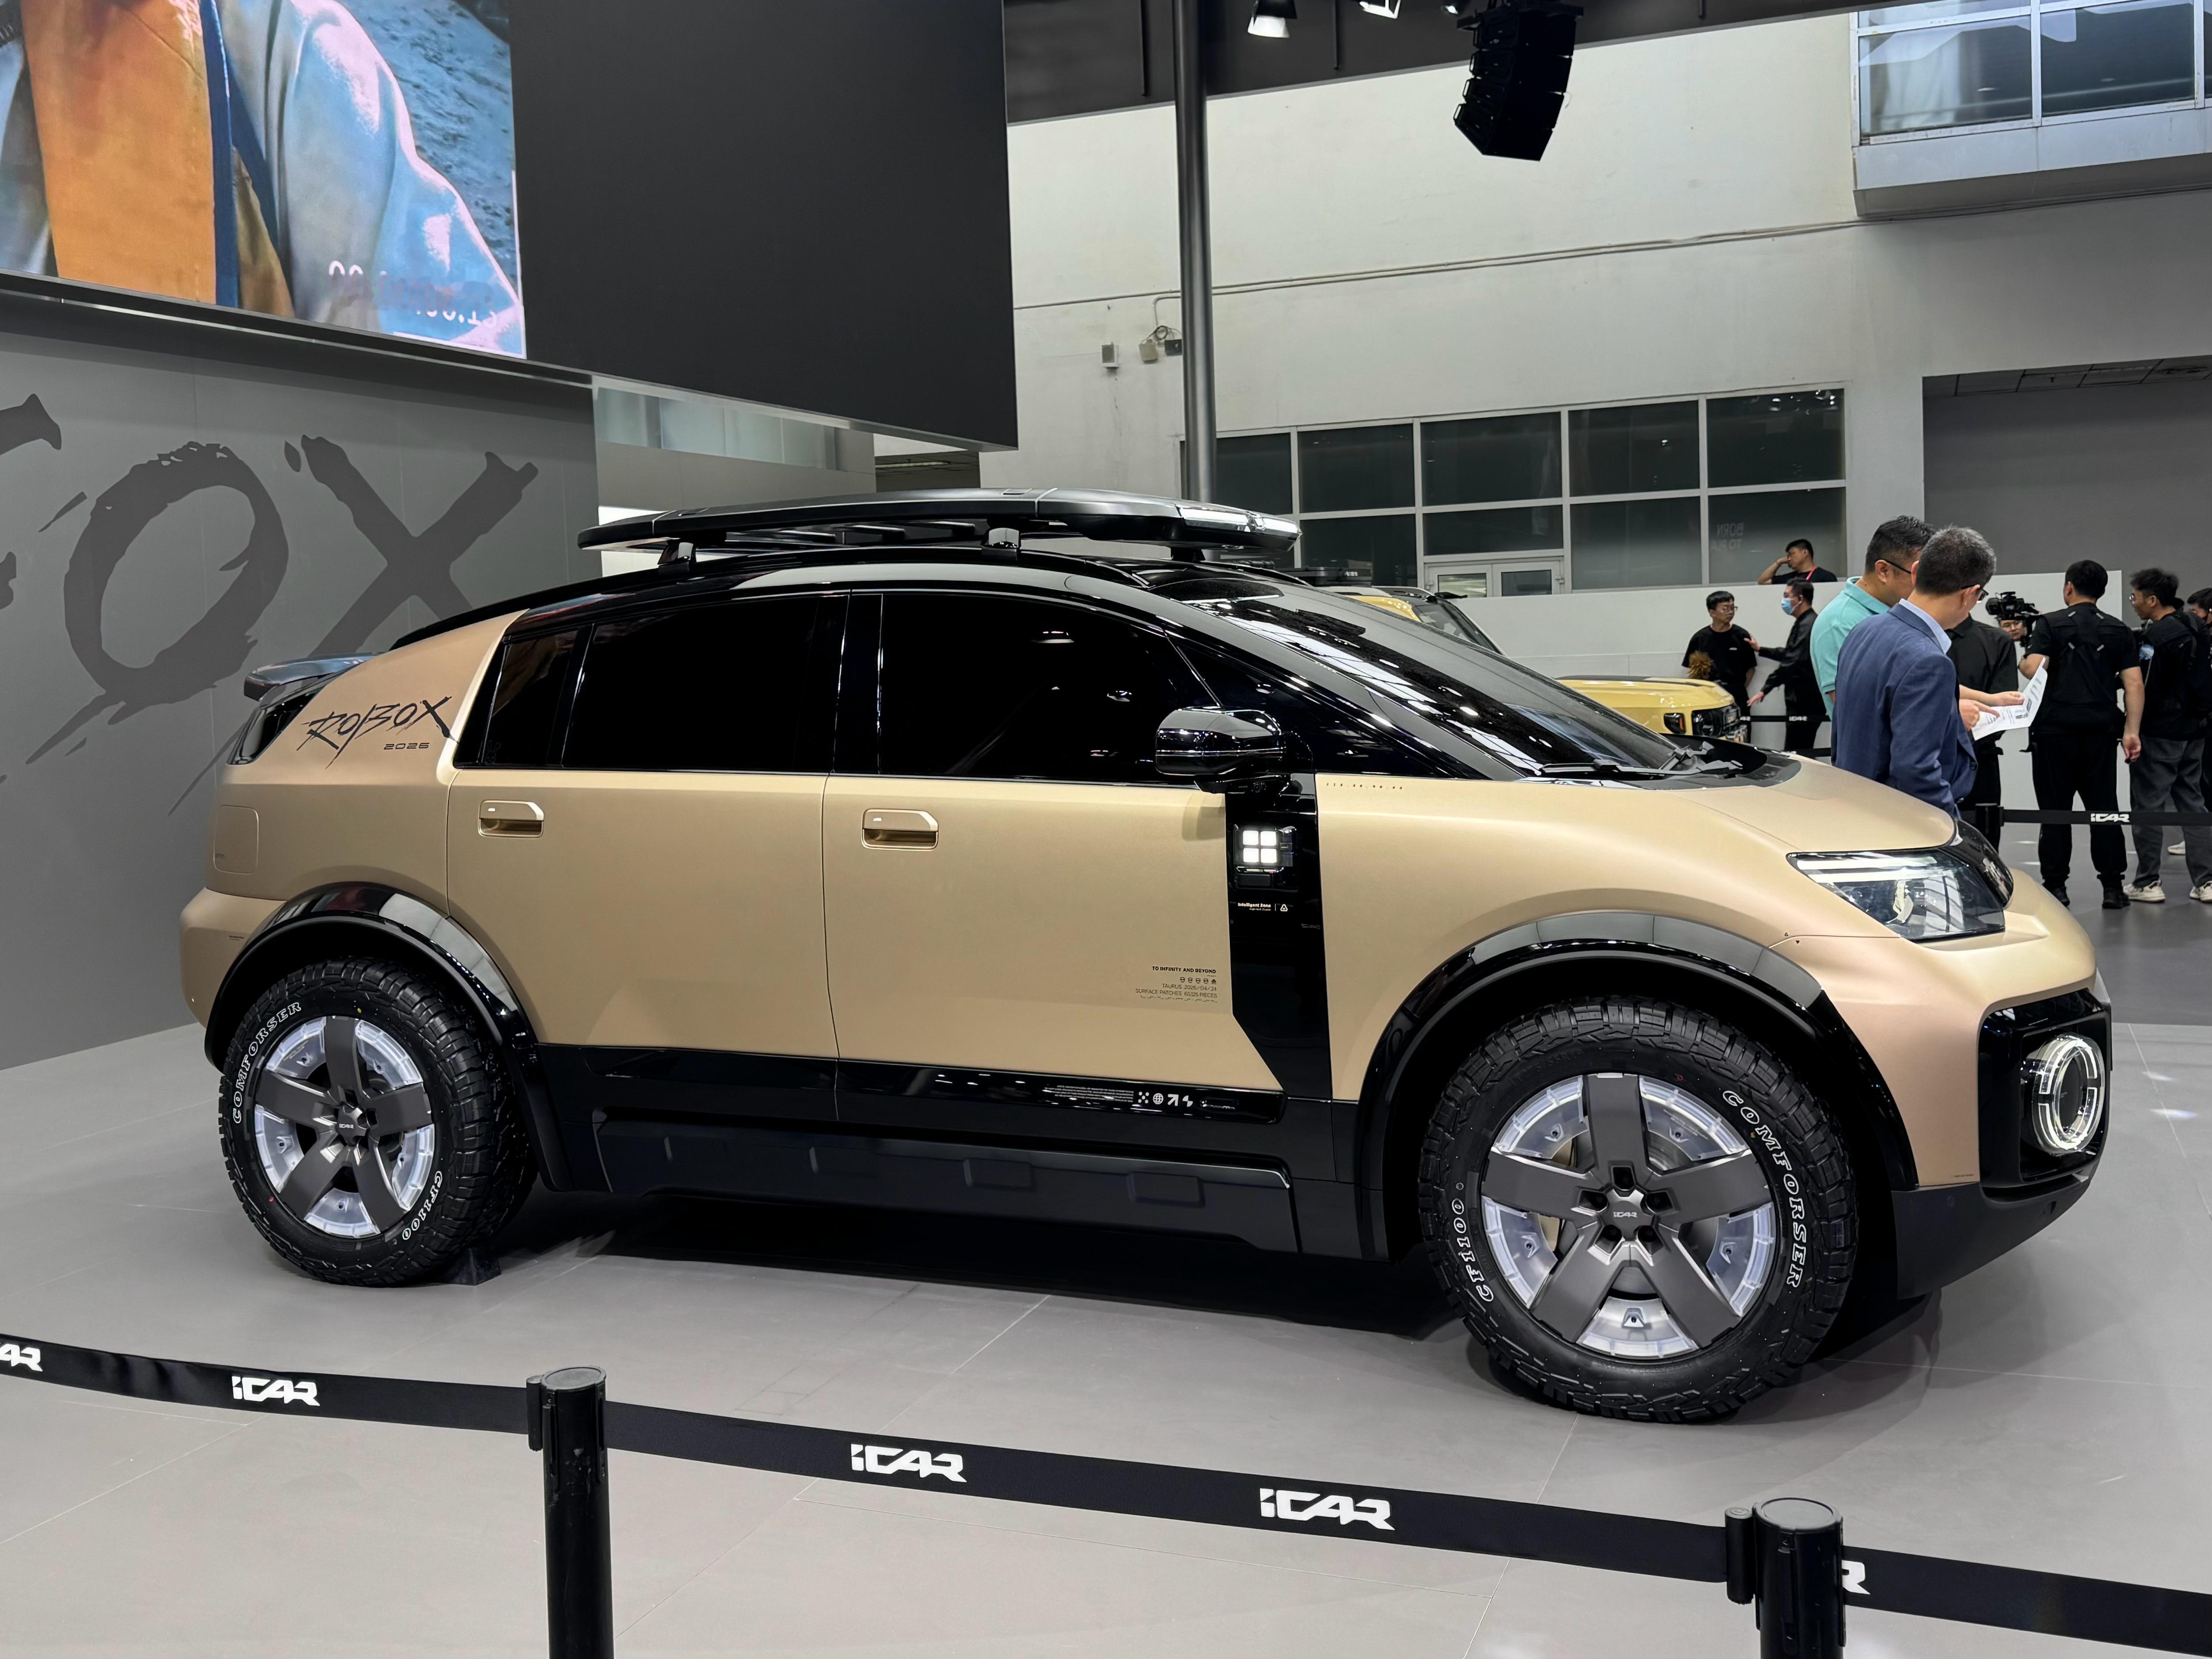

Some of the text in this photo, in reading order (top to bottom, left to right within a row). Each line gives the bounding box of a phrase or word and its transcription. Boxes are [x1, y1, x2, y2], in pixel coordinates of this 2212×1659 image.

[0, 393, 538, 817] OX
[297, 696, 458, 769] ROBOX
[233, 1002, 301, 1124] COMFORSER
[402, 1170, 443, 1240] CF1100
[1722, 1090, 1807, 1289] COMFORSER
[1451, 1199, 1495, 1302] CF1100
[0, 1343, 43, 1372] AR
